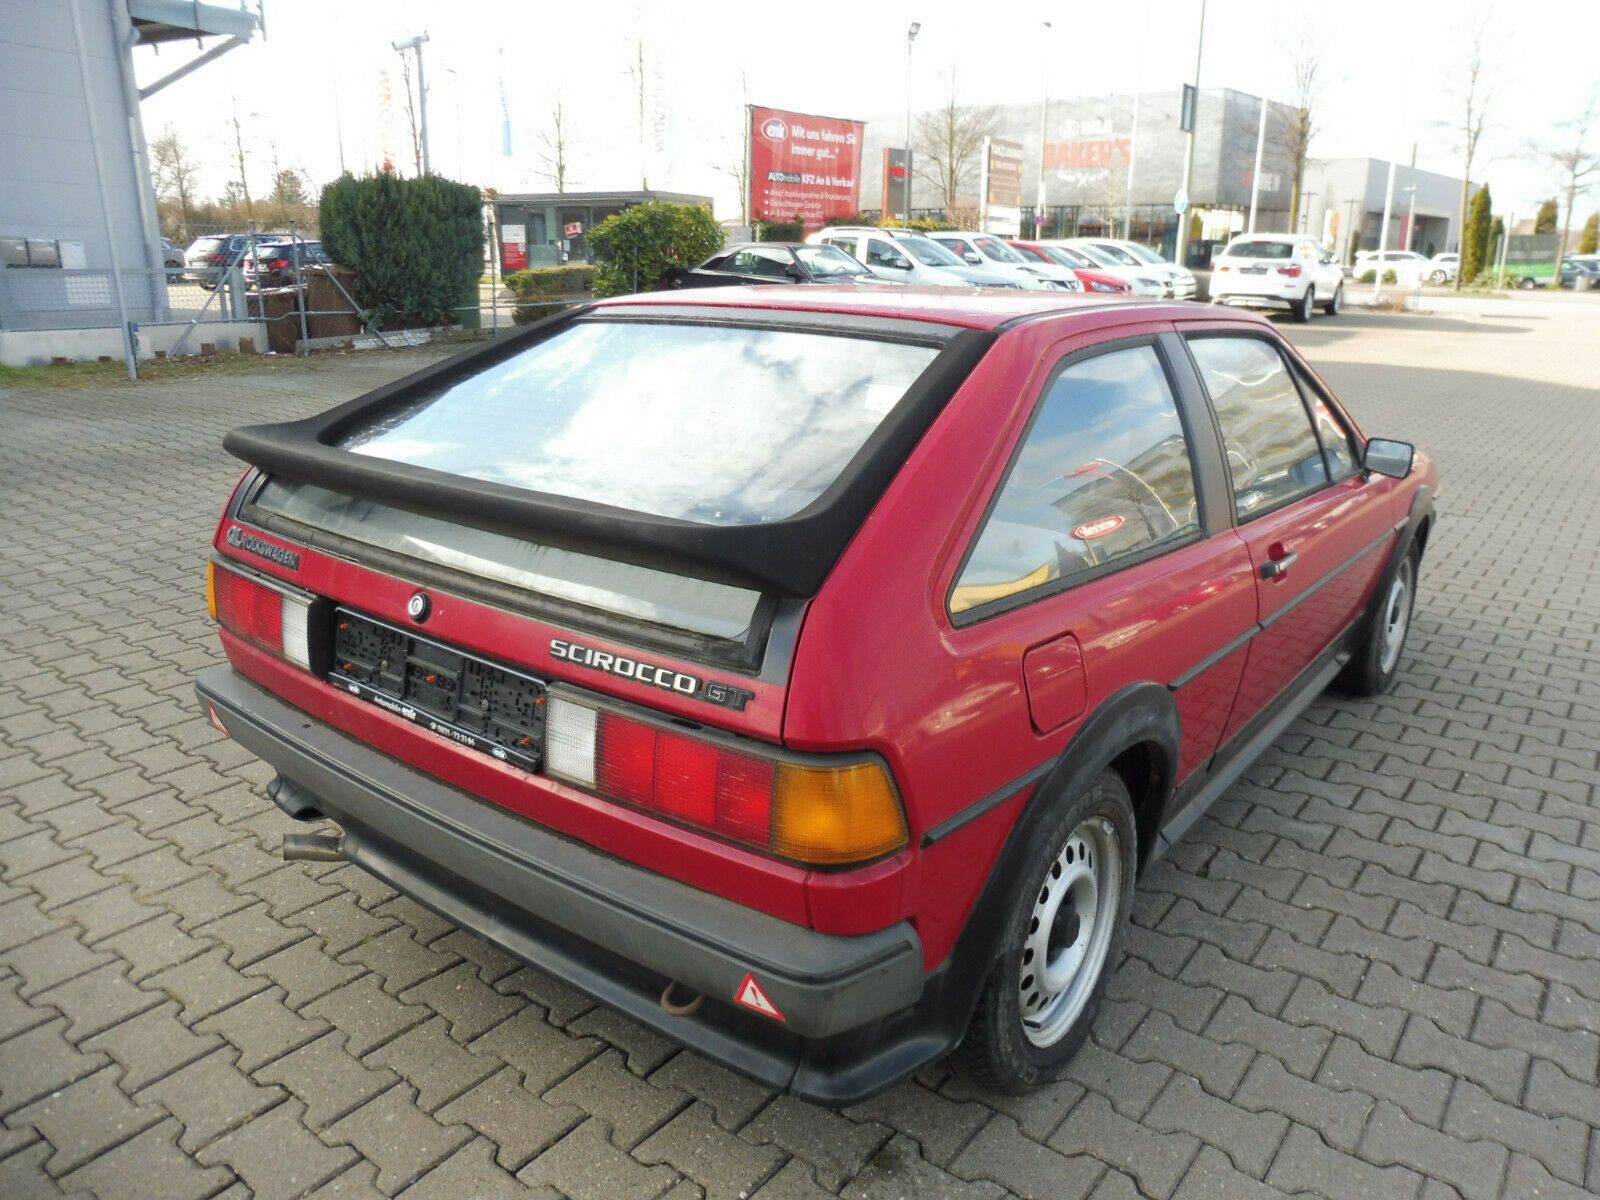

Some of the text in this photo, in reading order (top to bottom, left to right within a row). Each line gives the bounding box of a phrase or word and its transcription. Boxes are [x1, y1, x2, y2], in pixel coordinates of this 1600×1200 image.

[791, 125, 806, 140] Mit
[806, 130, 820, 141] uns
[821, 129, 845, 144] fahren
[768, 172, 801, 184] AUTOmobile
[801, 174, 815, 186] KFZ
[816, 176, 825, 186] An
[826, 177, 832, 186] &
[550, 639, 754, 711] SCIROCCO GT
